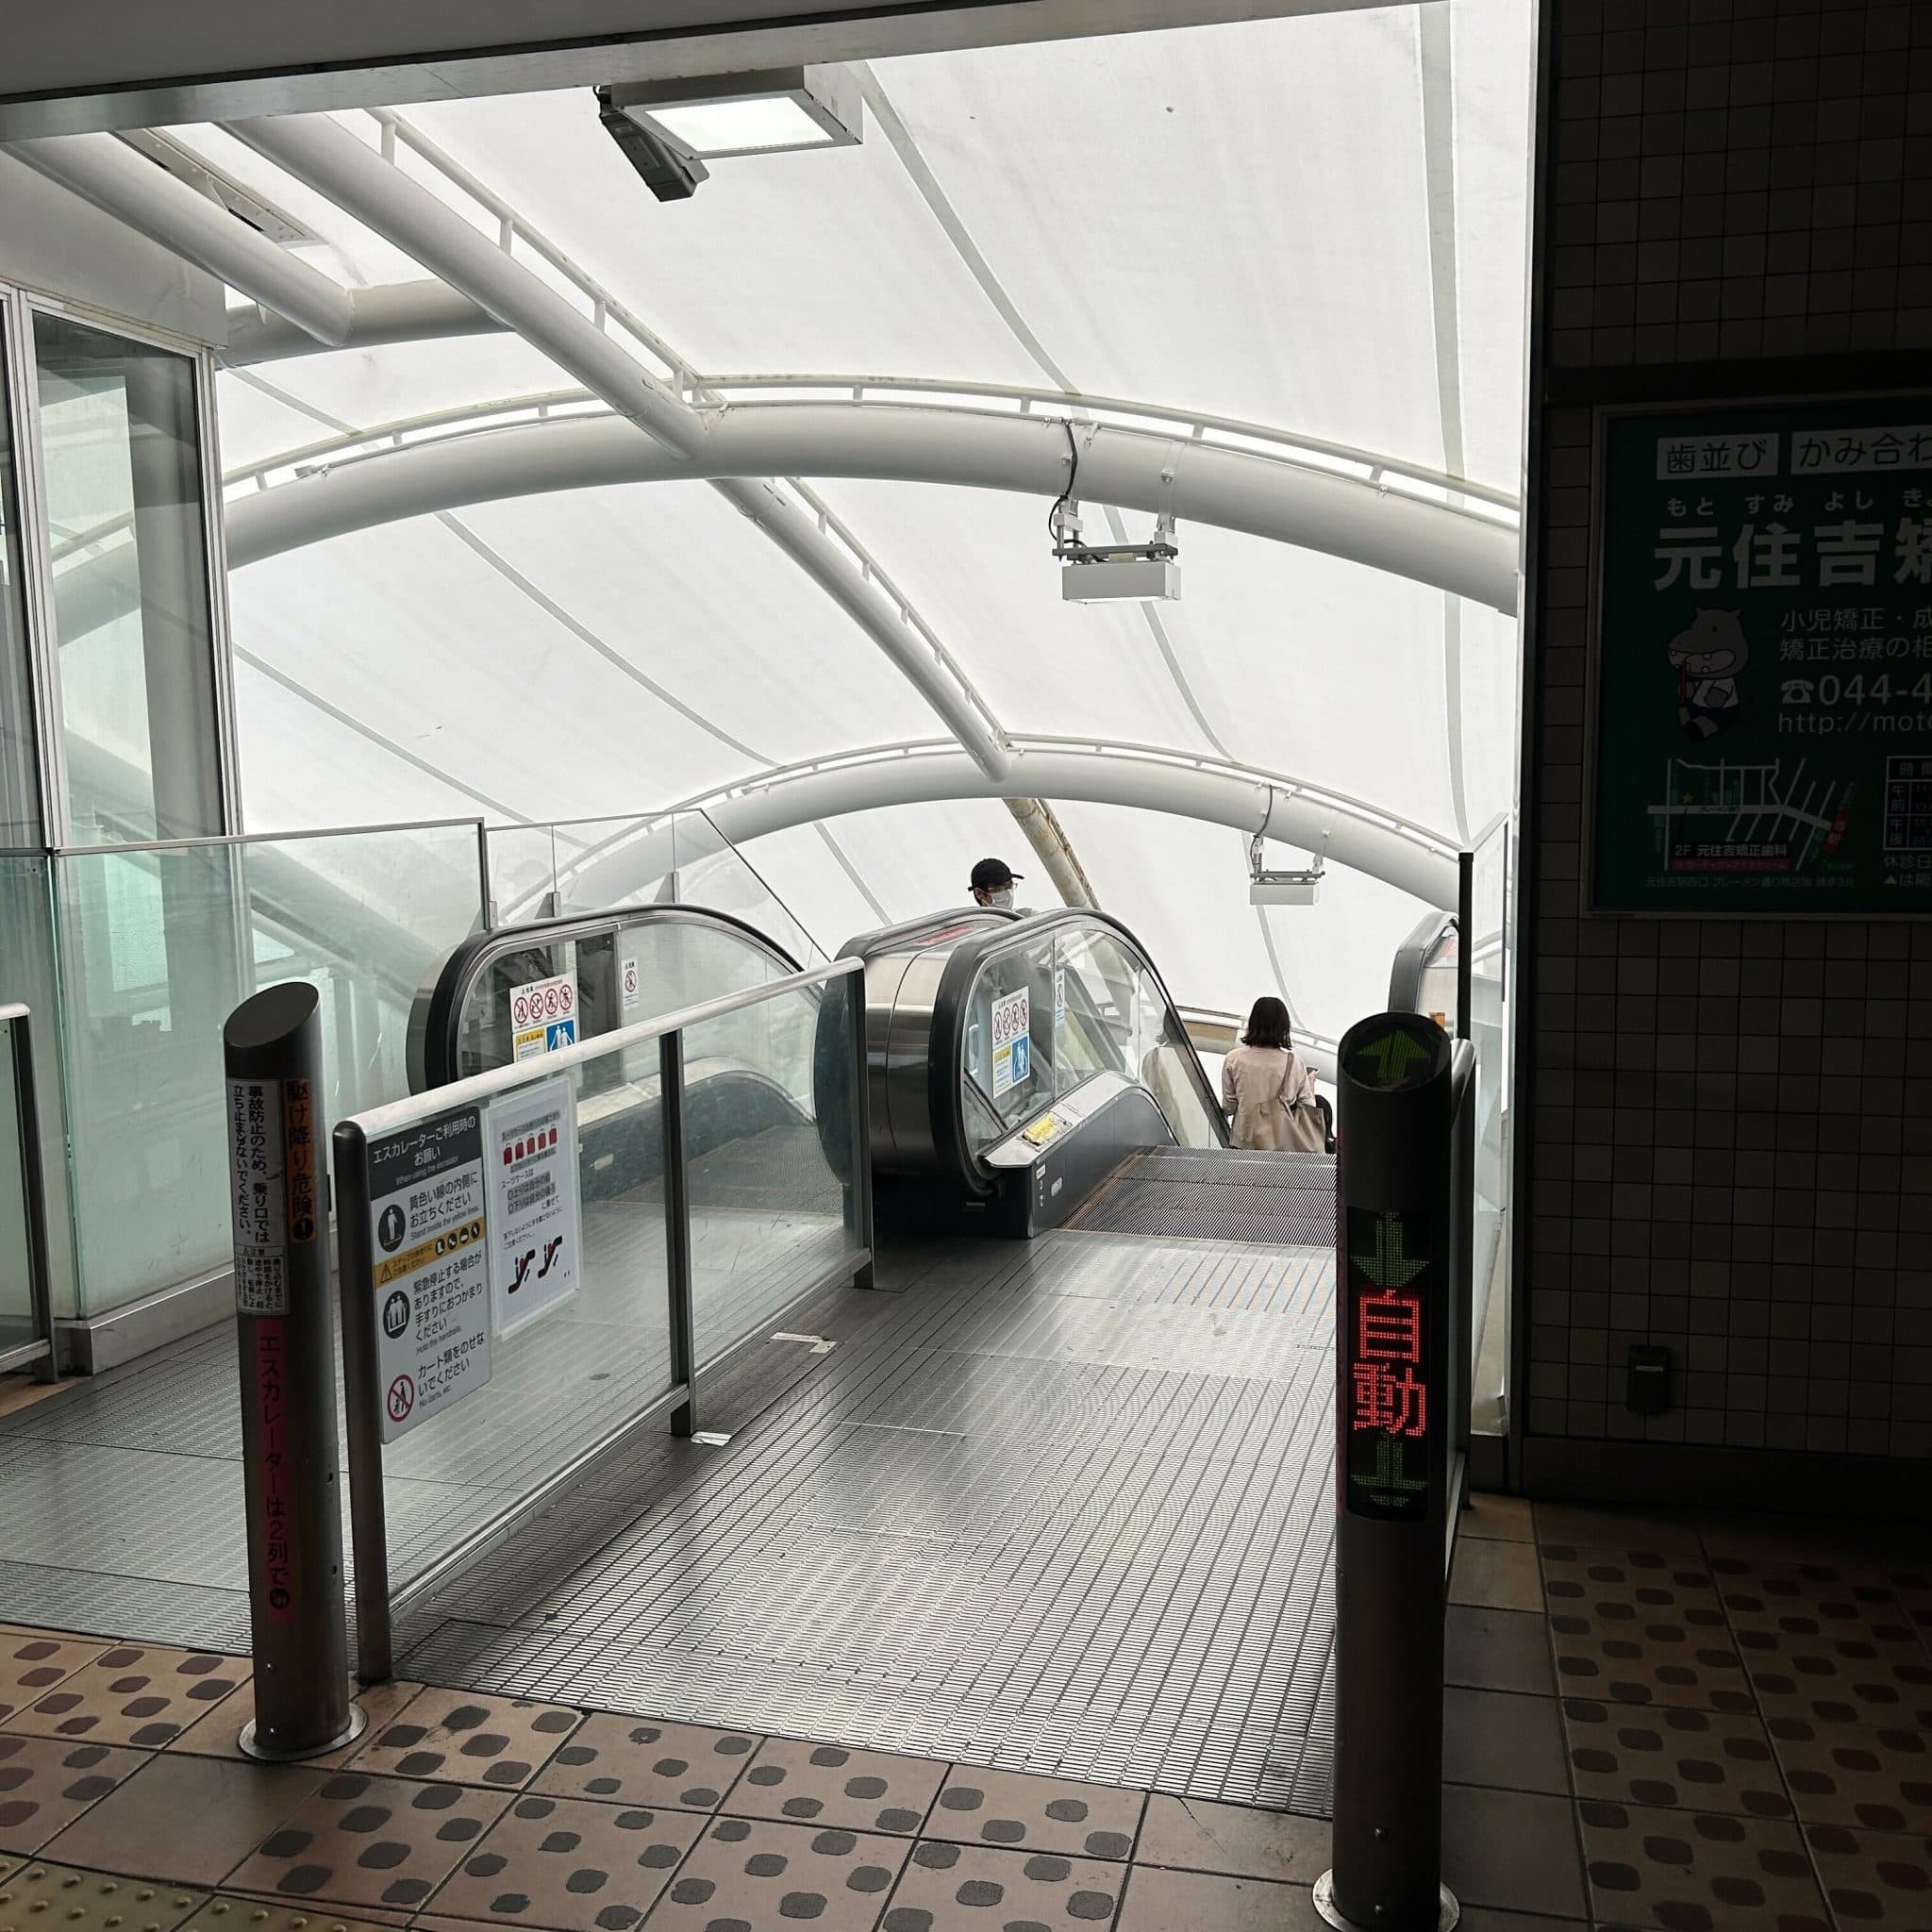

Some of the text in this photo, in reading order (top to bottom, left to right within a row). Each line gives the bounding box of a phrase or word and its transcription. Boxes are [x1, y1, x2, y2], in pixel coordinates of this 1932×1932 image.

[1667, 442, 1767, 474] 歯並び
[374, 1115, 476, 1164] エスカレーターご利用時の
[414, 1147, 441, 1167] お願い
[410, 1192, 472, 1228] お立ちください
[413, 1250, 482, 1295] 緊急停止する場合が
[415, 1283, 483, 1327] 手すりにおつかまり
[416, 1317, 448, 1341] ください
[418, 1332, 486, 1380] カート類をのせな
[1353, 1289, 1426, 1438] 自動
[419, 1358, 470, 1397] いでください
